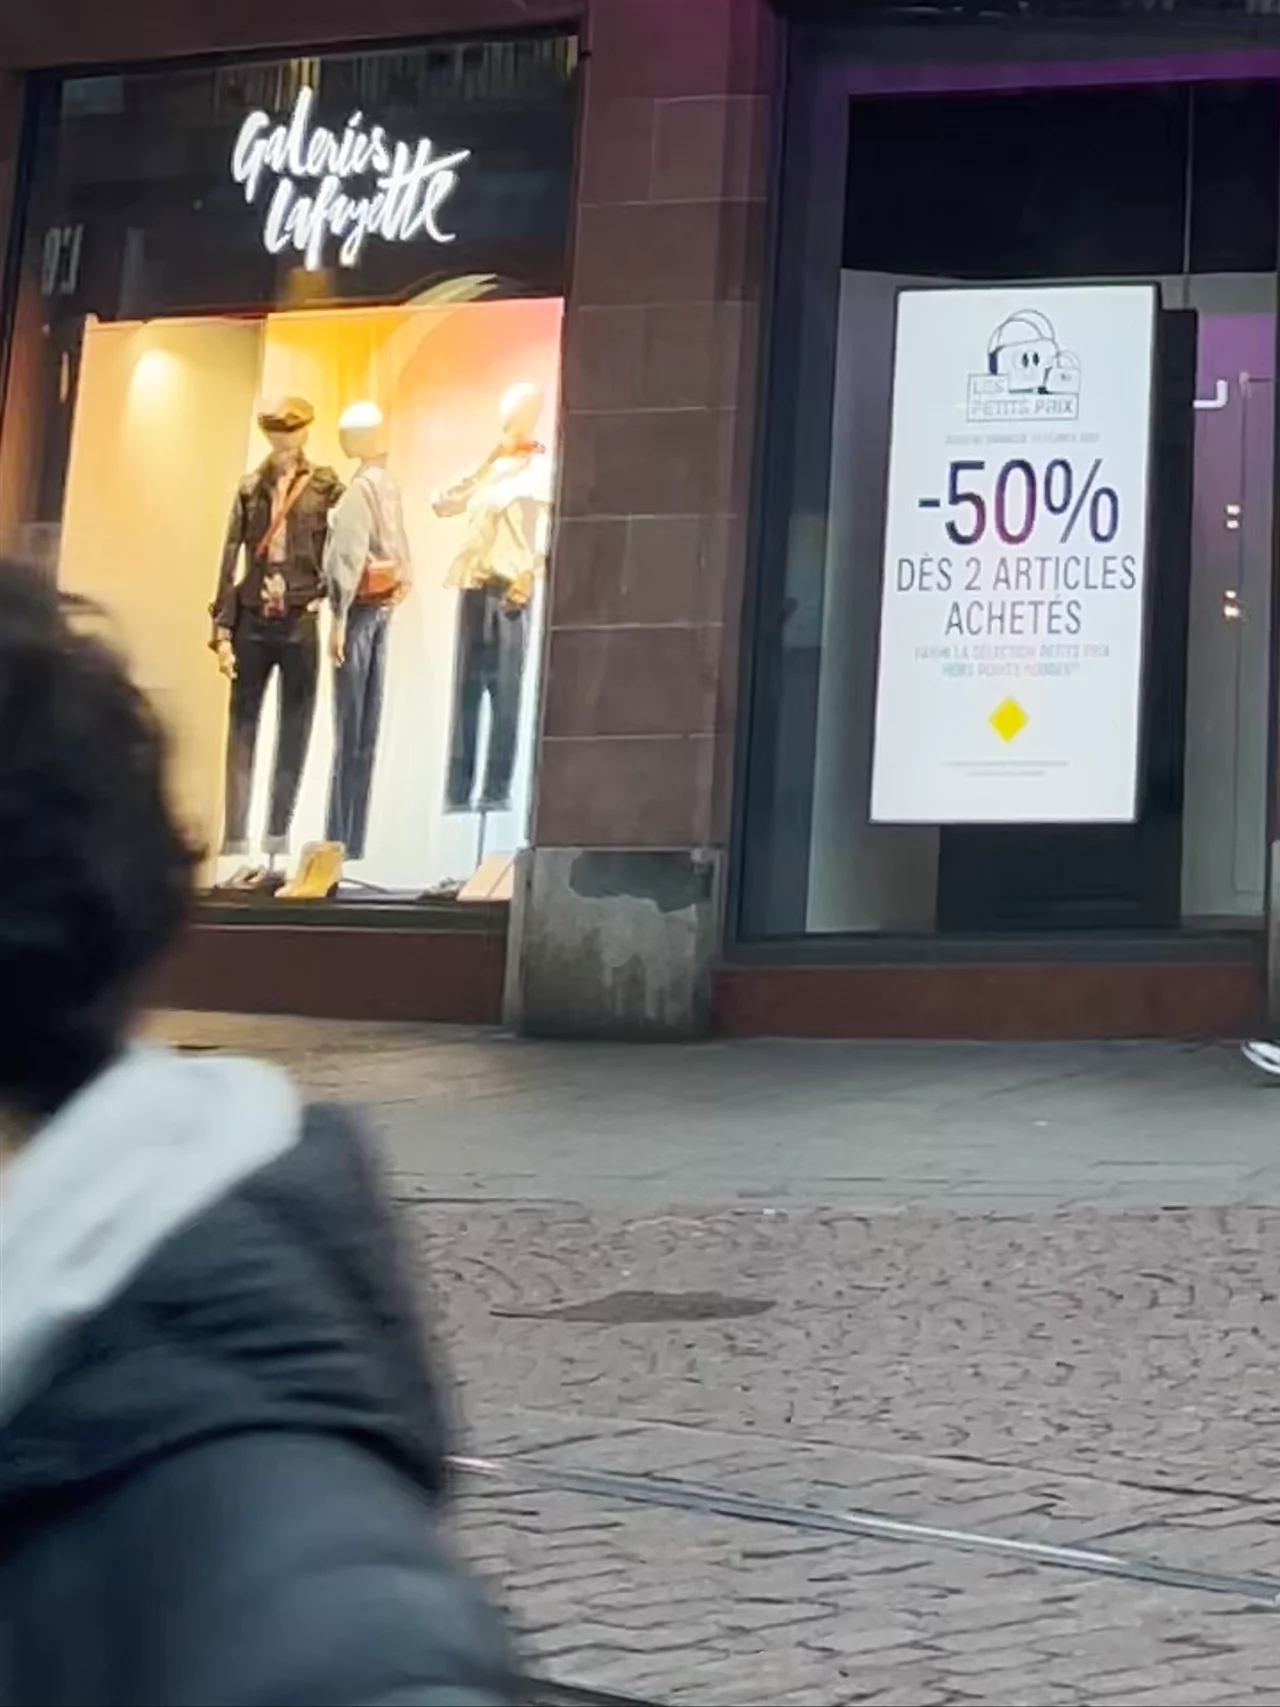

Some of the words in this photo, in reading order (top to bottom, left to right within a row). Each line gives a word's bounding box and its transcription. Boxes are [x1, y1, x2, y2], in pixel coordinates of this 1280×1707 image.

[232, 84, 391, 202] Galeries
[263, 138, 470, 271] Lafayette
[917, 458, 1119, 546] -50%
[896, 551, 953, 593] DÈS
[963, 556, 982, 592] 2
[992, 555, 1137, 592] ARTICLES
[945, 594, 1082, 637] ACHETÉS
